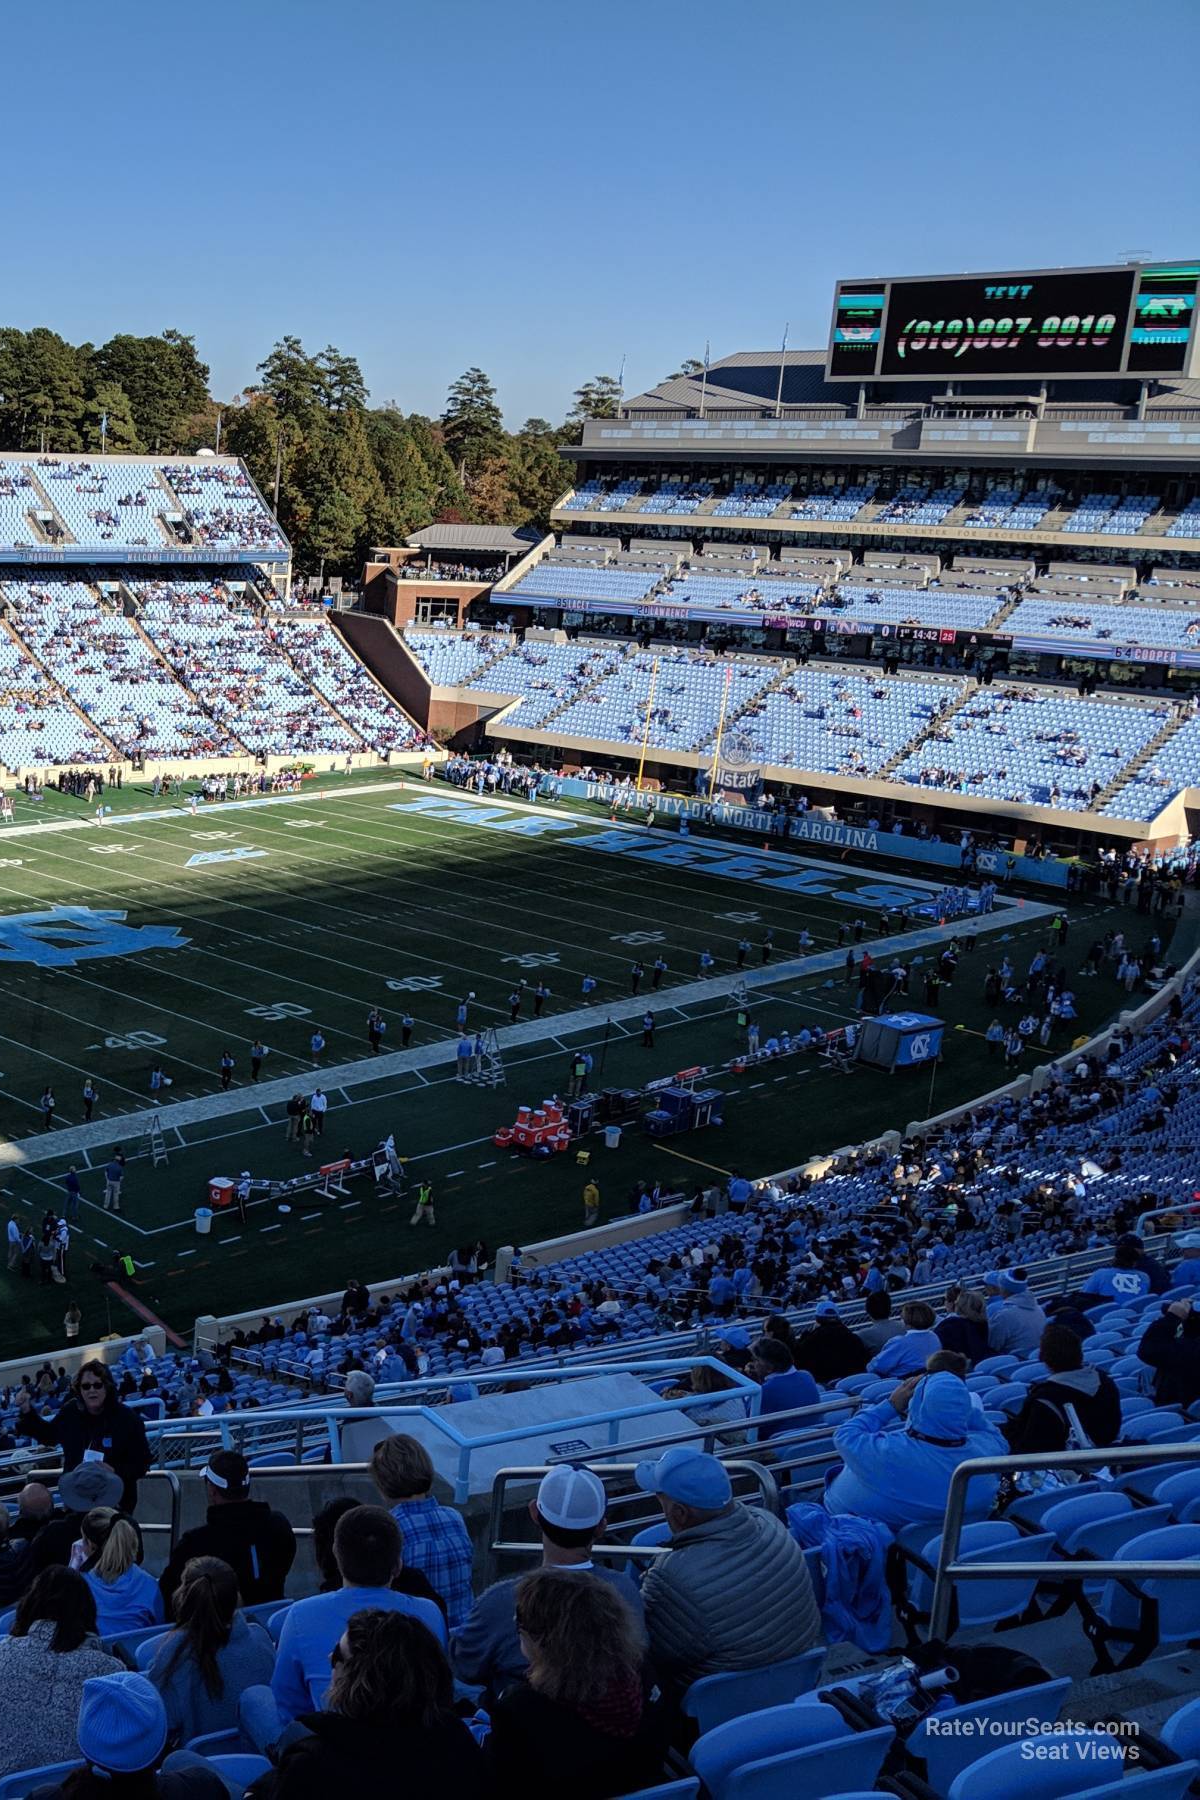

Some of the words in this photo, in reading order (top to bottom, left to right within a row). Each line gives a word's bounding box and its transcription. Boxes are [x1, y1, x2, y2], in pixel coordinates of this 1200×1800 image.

[127, 552, 163, 562] WELCOME
[166, 552, 175, 562] TO
[205, 552, 240, 562] STADIUM
[650, 606, 689, 618] LAWRENCE
[789, 618, 806, 628] WCU
[813, 620, 821, 631] 0
[857, 624, 874, 634] UNC
[882, 625, 889, 637] 0
[912, 629, 938, 641] 14:42
[942, 632, 953, 641] 25
[1116, 647, 1132, 658] 64
[1135, 648, 1177, 662] COOPER
[387, 796, 578, 836] TAR
[788, 819, 878, 850] CAROLINA
[557, 830, 938, 907] HEELS
[386, 975, 441, 992] 40
[243, 1002, 313, 1021] 50
[104, 1030, 168, 1050] 40
